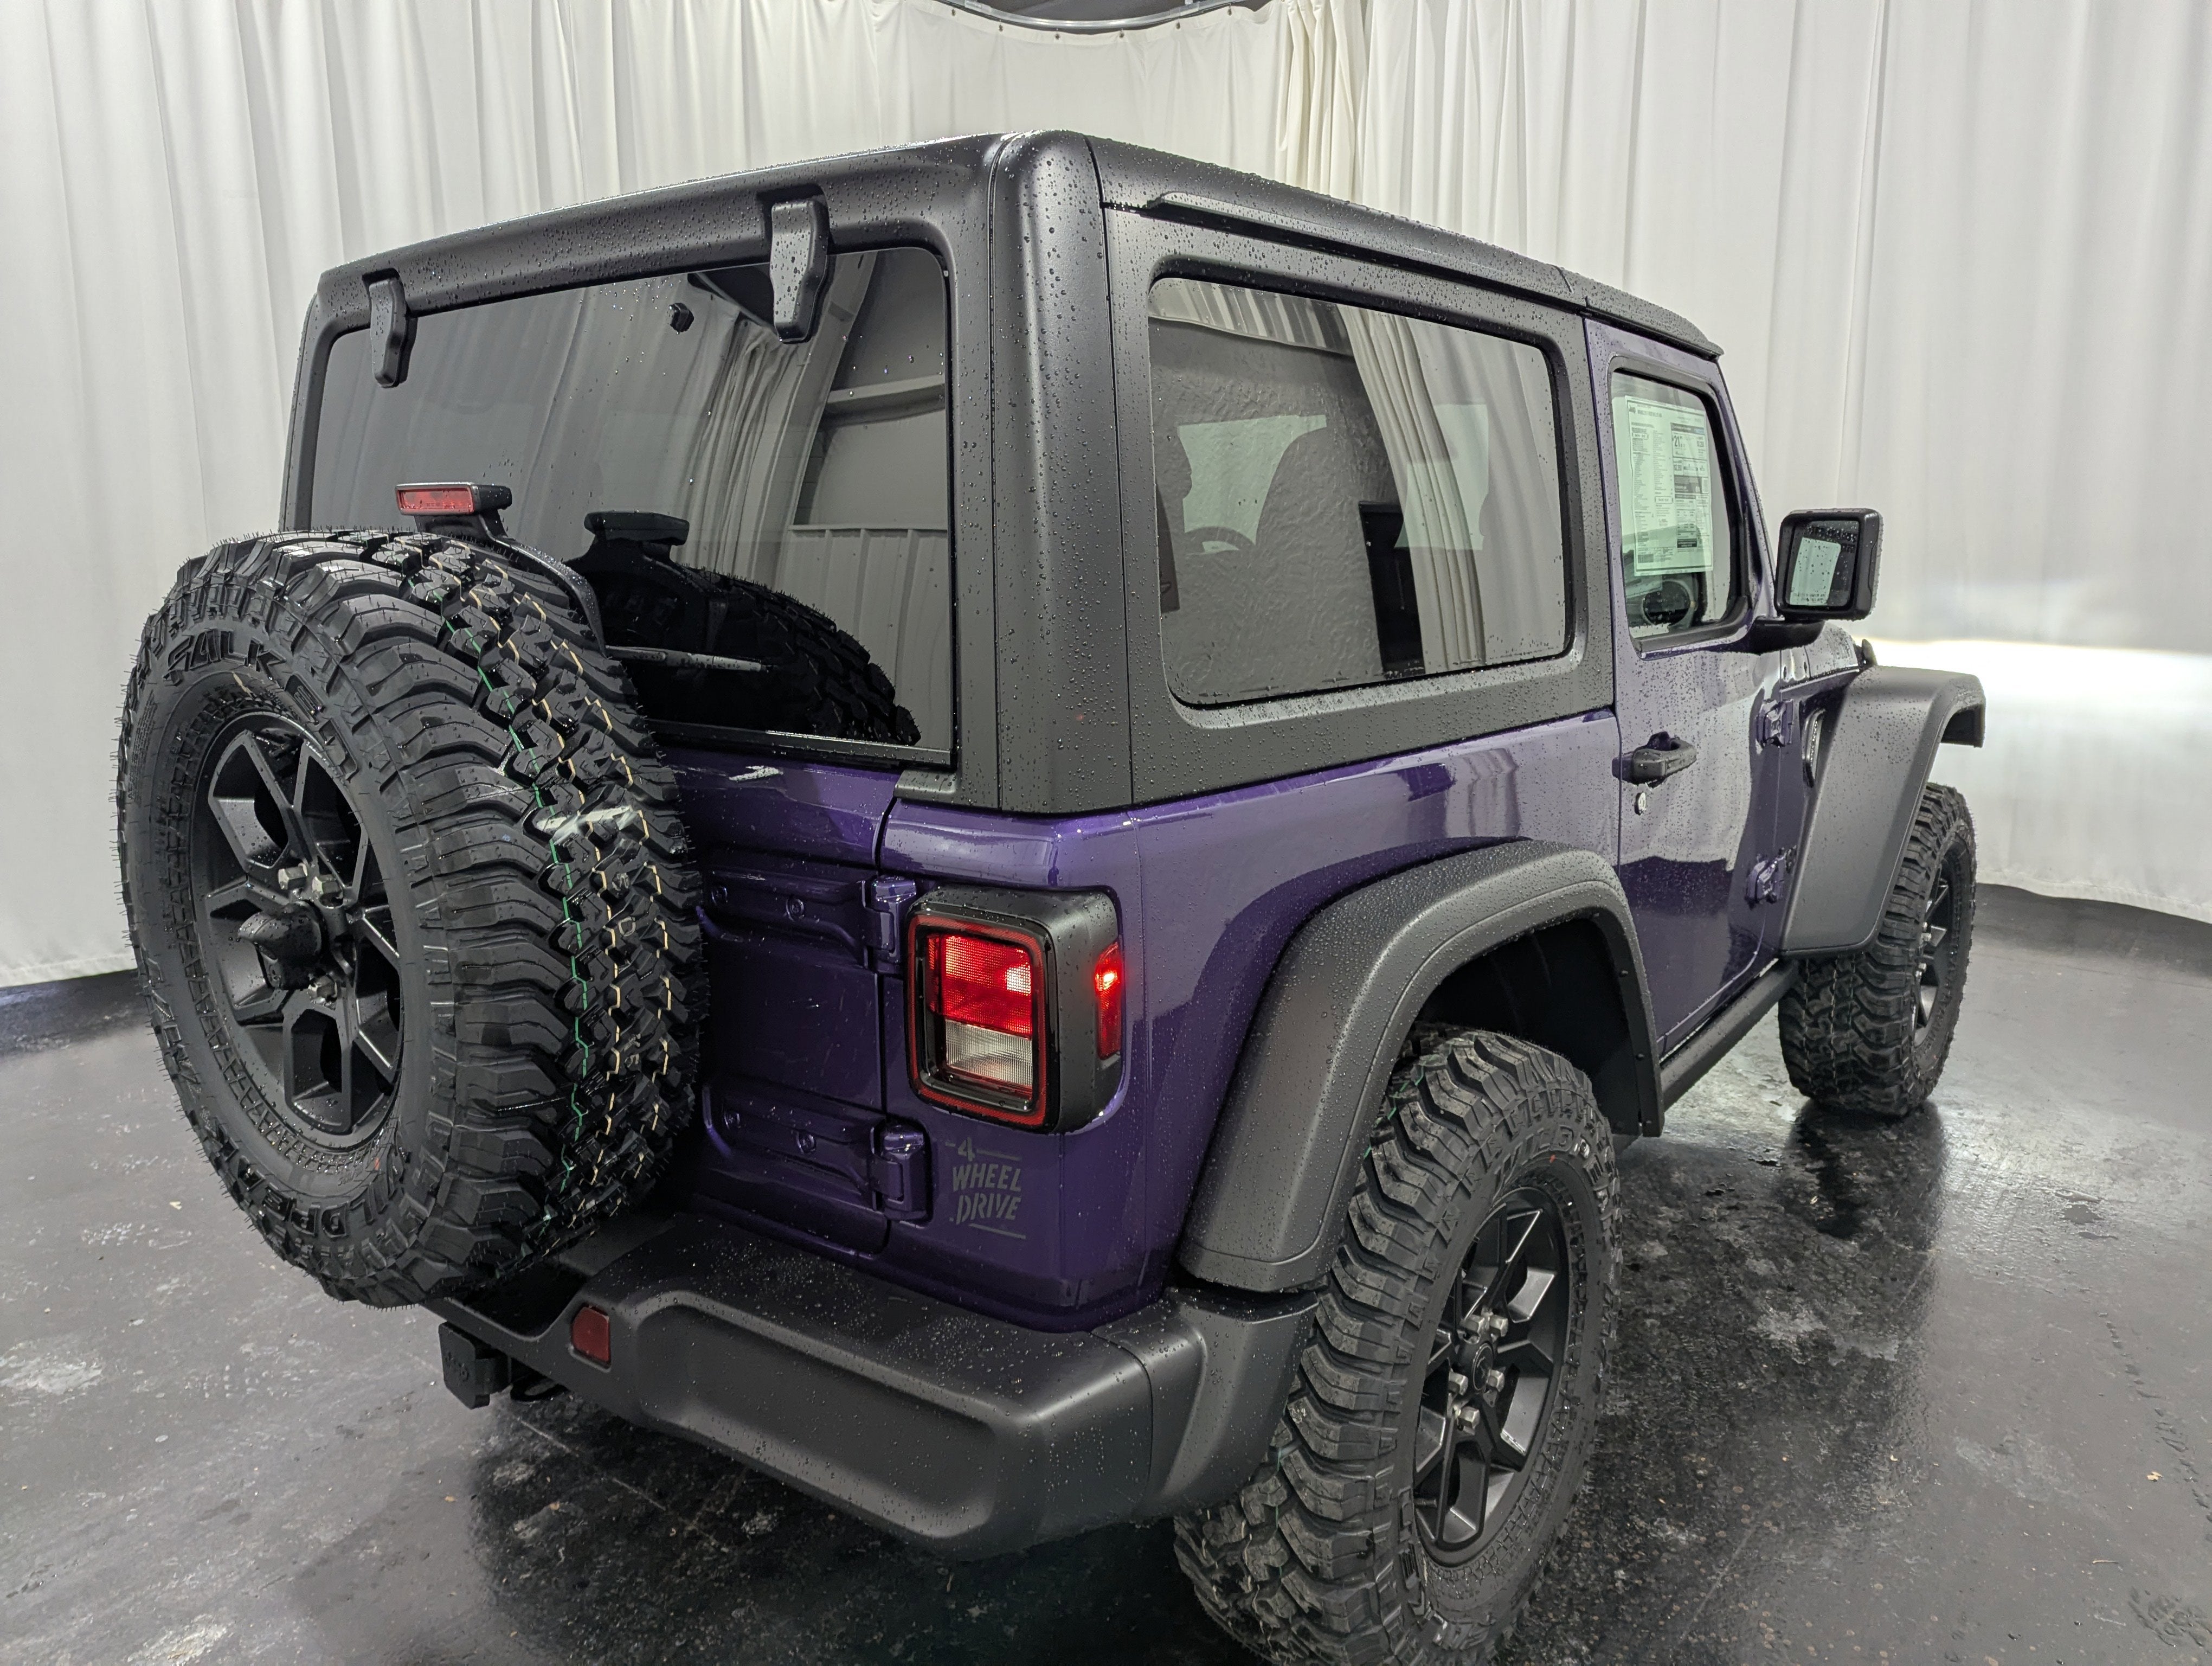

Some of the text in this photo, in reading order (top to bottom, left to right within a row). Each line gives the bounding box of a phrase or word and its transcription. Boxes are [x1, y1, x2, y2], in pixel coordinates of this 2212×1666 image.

[957, 1137, 975, 1162] 4
[953, 1163, 1021, 1192] WHEEL
[956, 1193, 1021, 1225] DRIVE
